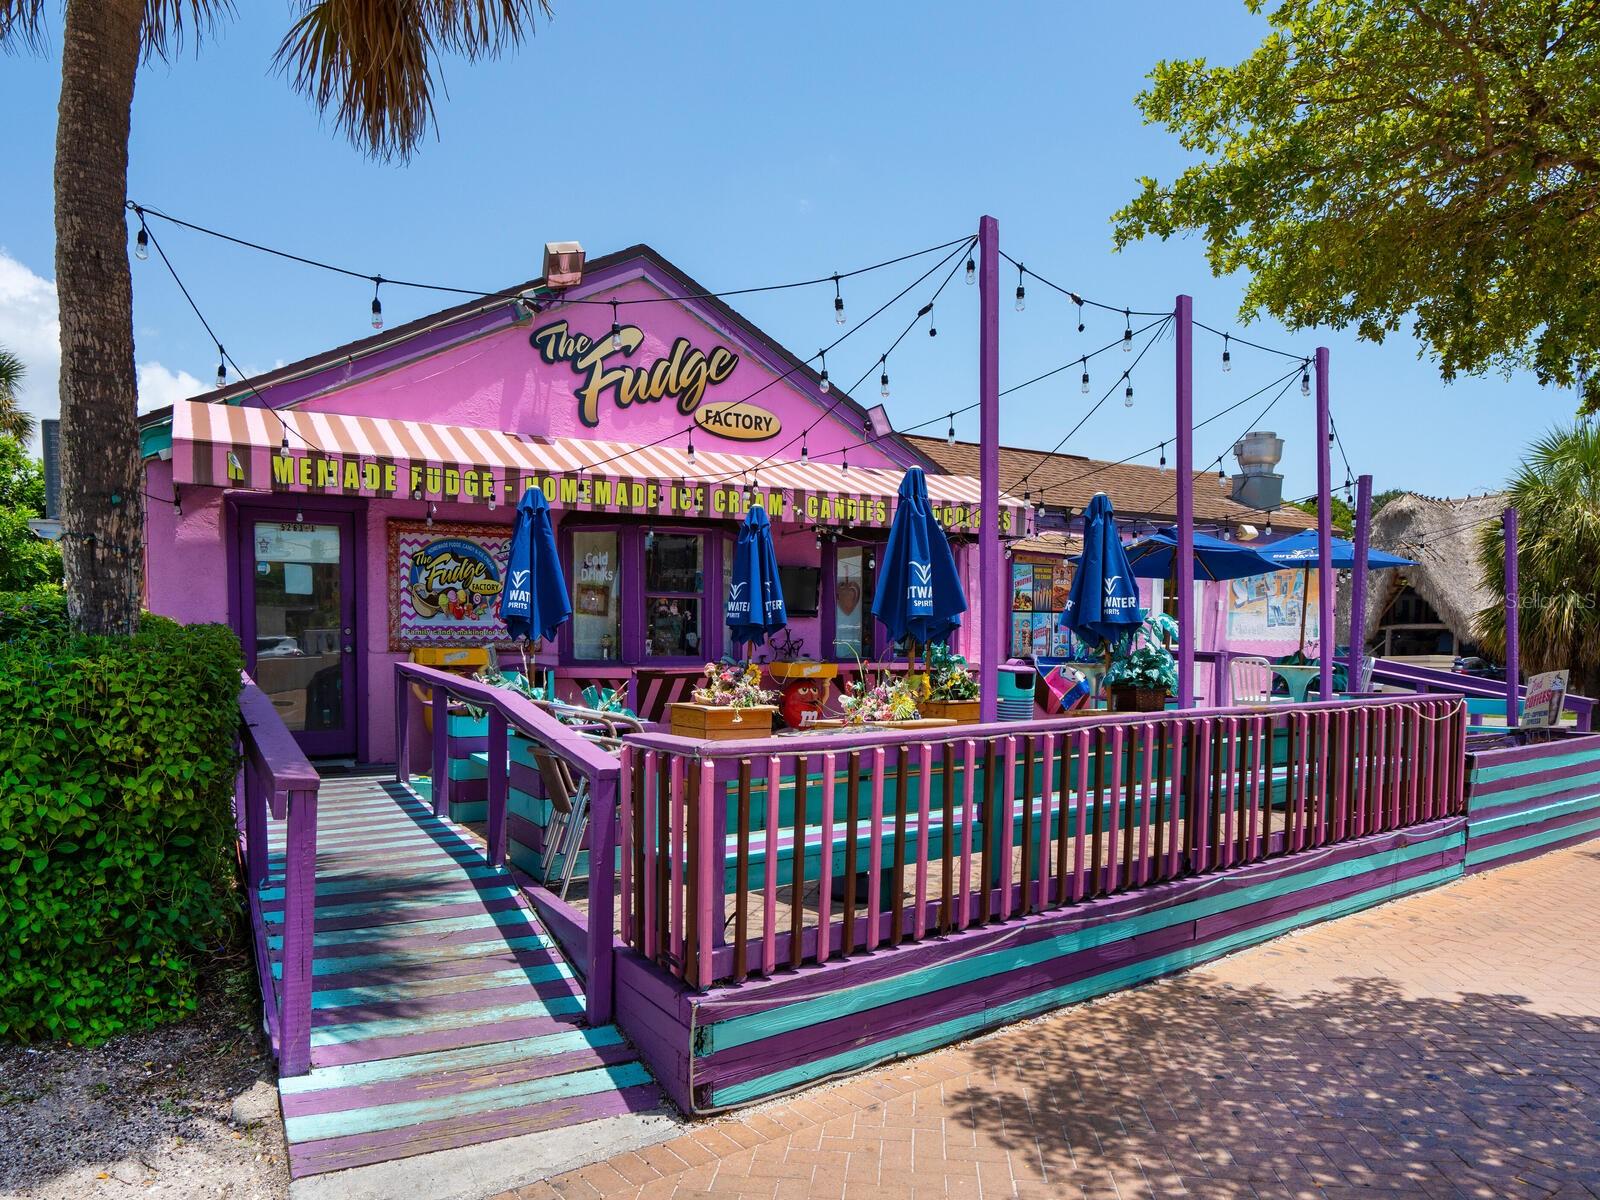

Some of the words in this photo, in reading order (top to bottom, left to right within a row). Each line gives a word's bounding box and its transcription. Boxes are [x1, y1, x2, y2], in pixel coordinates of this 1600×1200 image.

[530, 320, 593, 364] The
[571, 325, 738, 428] Fudge
[704, 409, 773, 432] FACTORY
[227, 451, 397, 491] HMEMADE
[411, 466, 494, 497] FUDGE
[671, 486, 703, 511] ICE
[807, 496, 886, 522] CANDIES
[412, 550, 432, 566] The
[585, 551, 609, 566] Cold
[425, 552, 487, 593] Fudge
[581, 567, 613, 581] Drinks
[471, 583, 500, 591] FACTORY
